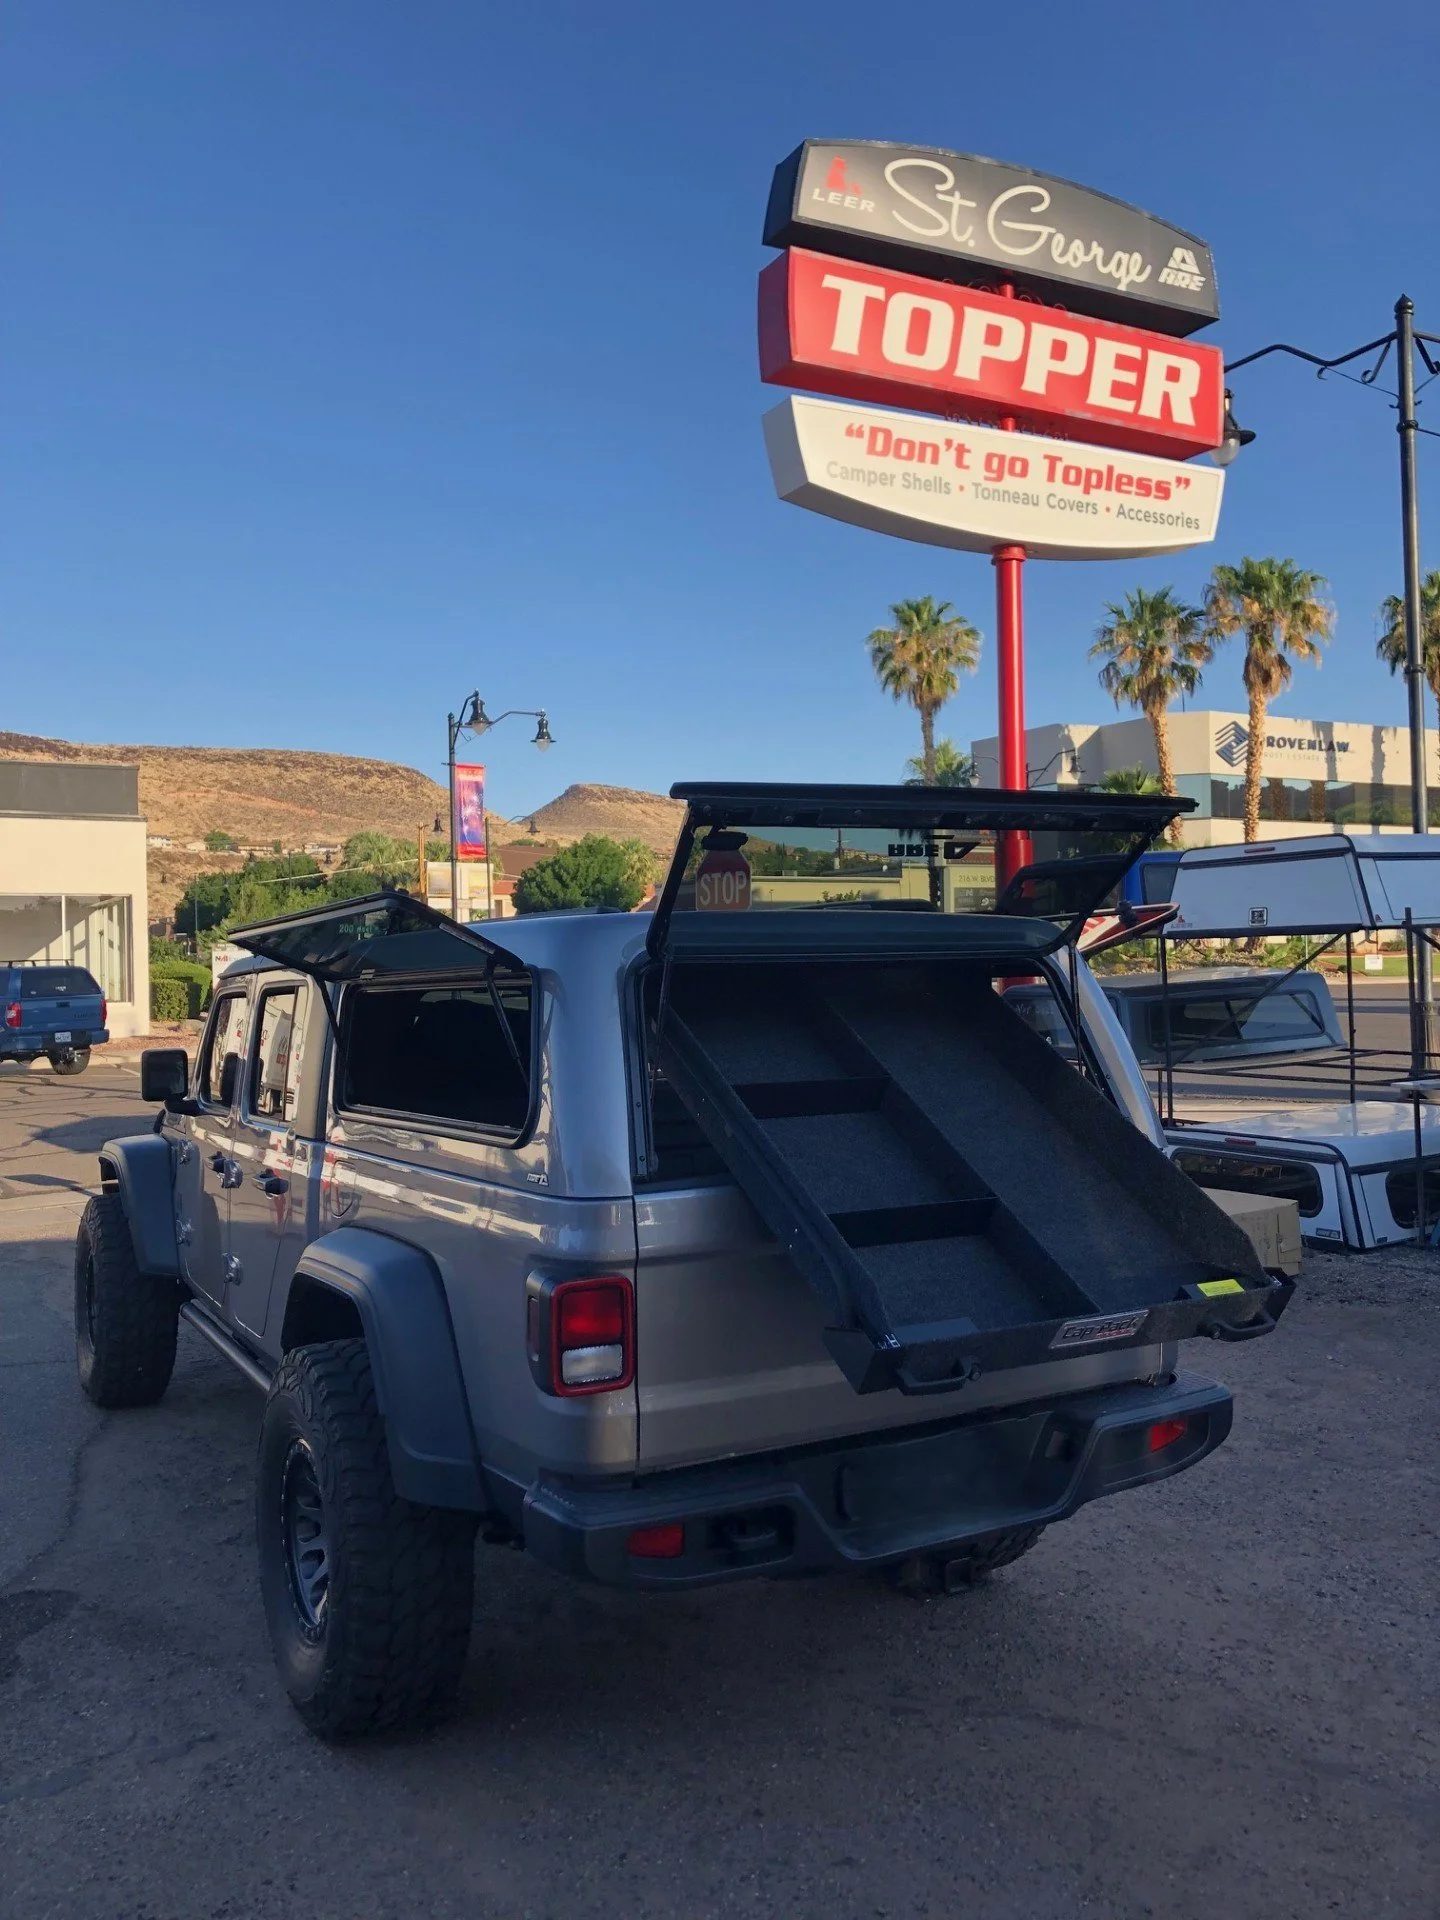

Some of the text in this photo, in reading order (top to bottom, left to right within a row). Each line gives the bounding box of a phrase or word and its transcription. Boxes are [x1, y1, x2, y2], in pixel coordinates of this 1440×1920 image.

[812, 188, 876, 213] LEER
[884, 158, 1152, 291] St. George
[822, 274, 1201, 426] TOPPER
[826, 461, 1200, 530] Camper Shells Tonneau Covers Accessories
[984, 452, 1029, 483] go
[1043, 454, 1191, 501] Topless”
[1265, 735, 1350, 753] ROVENLAW
[700, 870, 748, 906] STOP
